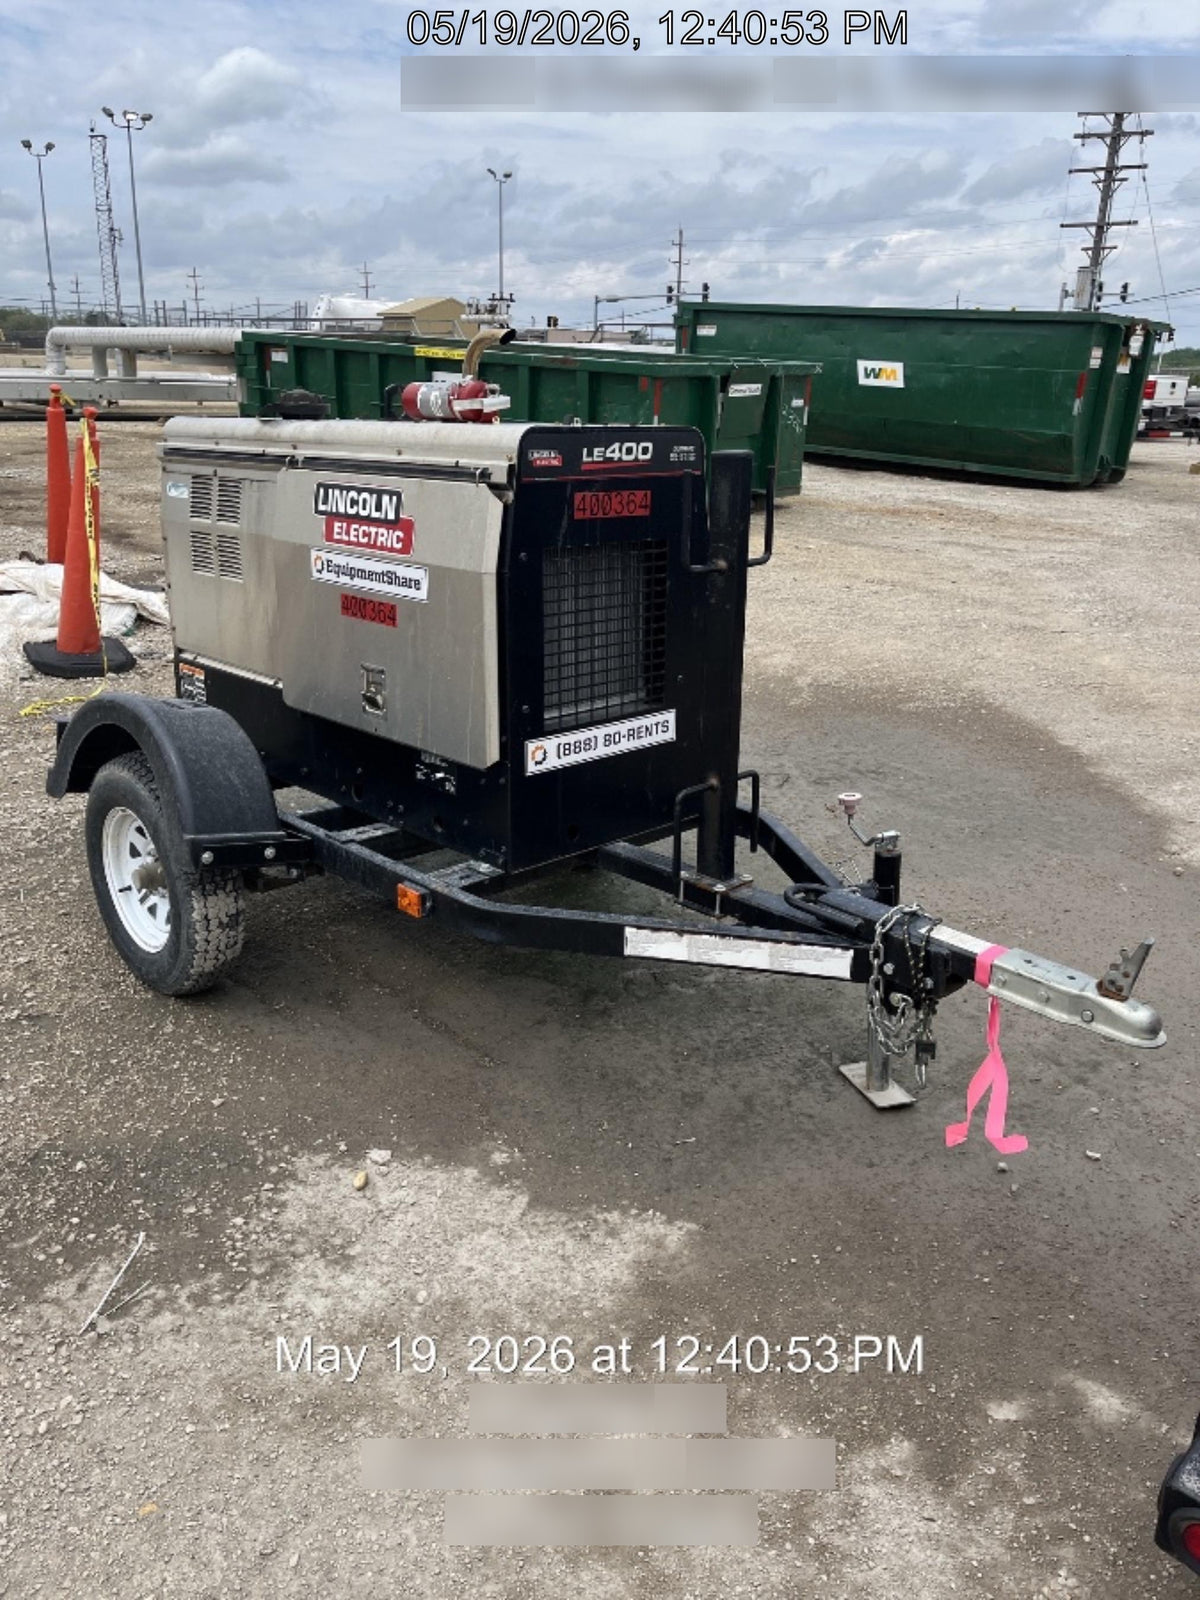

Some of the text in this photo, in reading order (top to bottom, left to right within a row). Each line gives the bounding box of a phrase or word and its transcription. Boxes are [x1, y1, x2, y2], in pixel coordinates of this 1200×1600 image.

[864, 366, 897, 381] WM
[582, 442, 653, 462] LE400
[318, 487, 397, 520] LINCOLN
[575, 491, 650, 516] 400364
[333, 522, 404, 549] ELECTRIC
[326, 559, 422, 591] EquipmentShare
[342, 595, 397, 626] 400364
[556, 735, 598, 759] (888)
